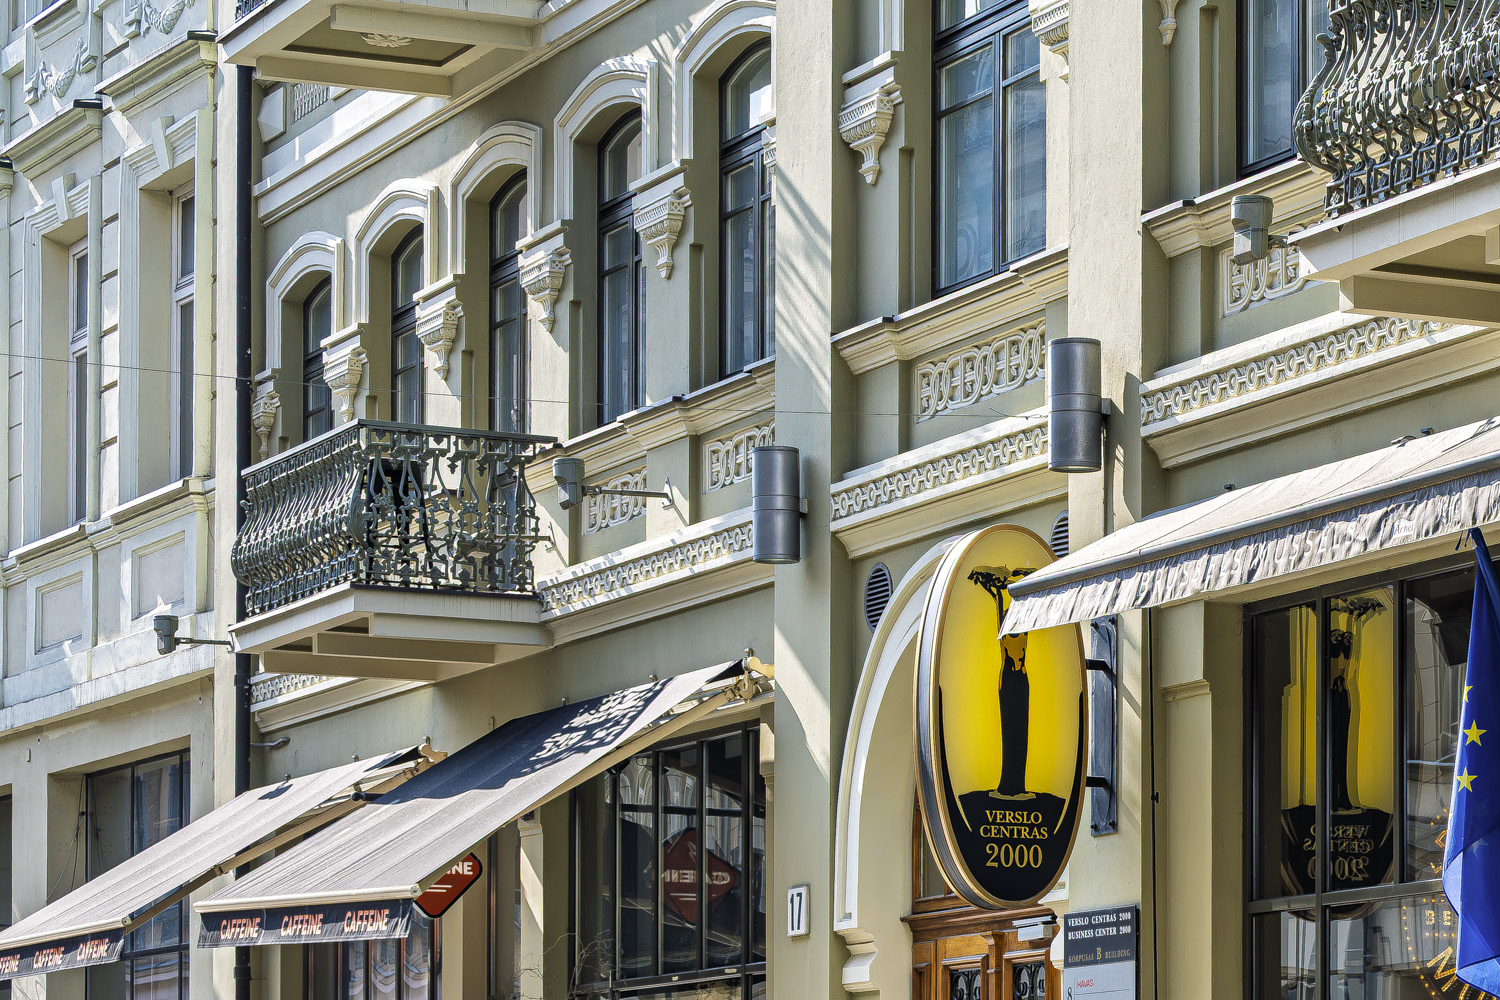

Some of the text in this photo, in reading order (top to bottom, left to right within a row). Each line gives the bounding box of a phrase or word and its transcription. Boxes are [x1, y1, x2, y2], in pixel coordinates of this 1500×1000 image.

[985, 810, 1043, 825] VERSLO
[980, 825, 1049, 840] CENTRAS
[985, 843, 1043, 869] 2000
[343, 909, 389, 932] CAFFEINE
[789, 892, 803, 932] 17
[1068, 911, 1131, 927] VERSLO CENTRAS 2000
[220, 917, 261, 940] CAFFEINE
[280, 913, 323, 937] CAFFEINE
[1068, 925, 1132, 940] BUSINESS CENTER 2000
[33, 946, 65, 969] CAFFEINE
[76, 938, 109, 961] CAFFEINE
[1068, 947, 1131, 963] KORPUSAS B BUILDING
[1077, 979, 1094, 988] HAVAS
